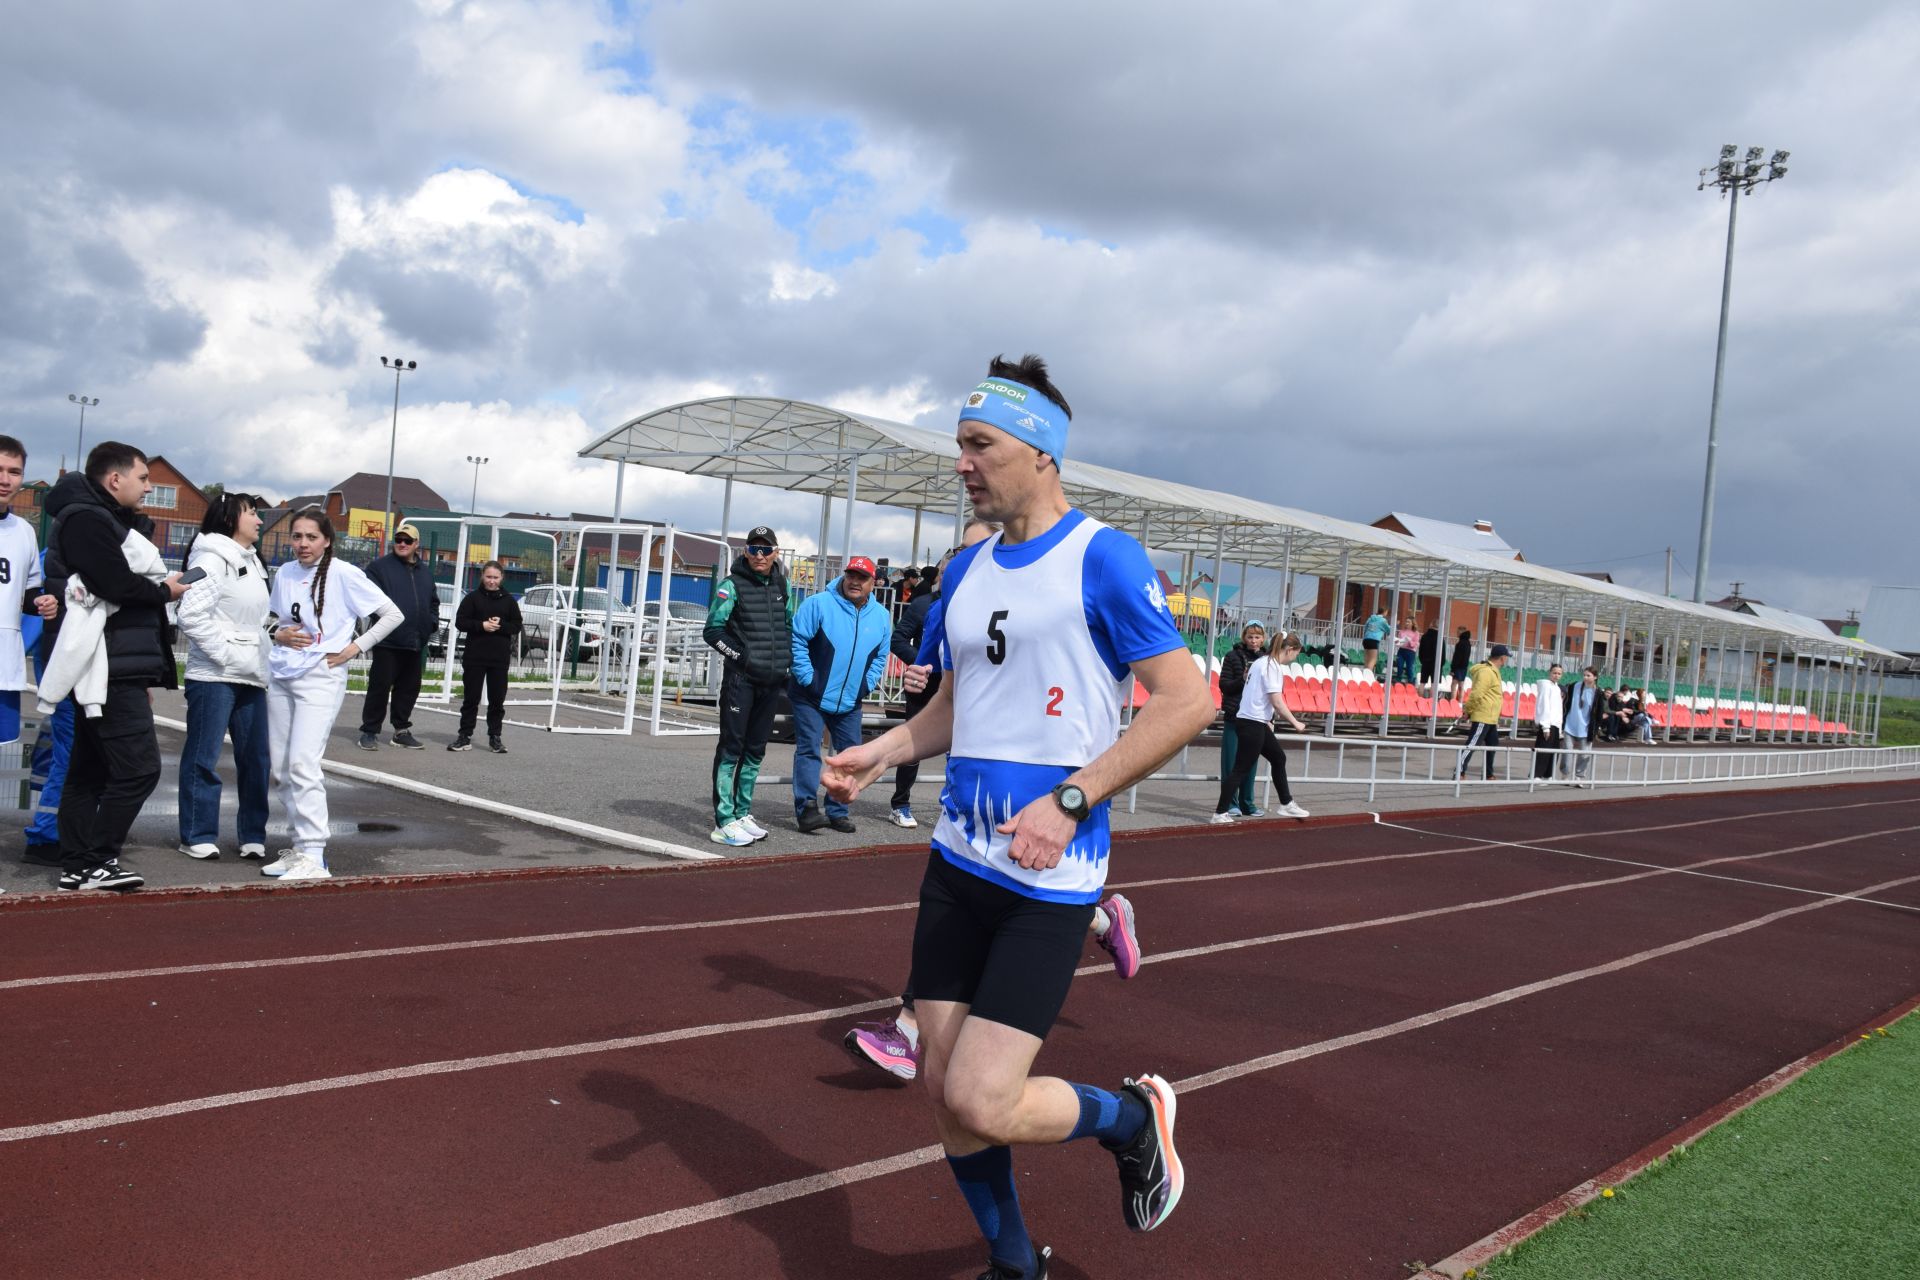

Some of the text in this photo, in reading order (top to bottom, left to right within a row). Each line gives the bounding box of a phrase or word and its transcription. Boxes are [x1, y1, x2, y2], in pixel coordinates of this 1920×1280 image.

[0, 557, 11, 584] 9
[291, 602, 301, 623] 9
[986, 610, 1009, 665] 5
[1046, 686, 1064, 716] 2
[886, 1044, 906, 1057] HOKA
